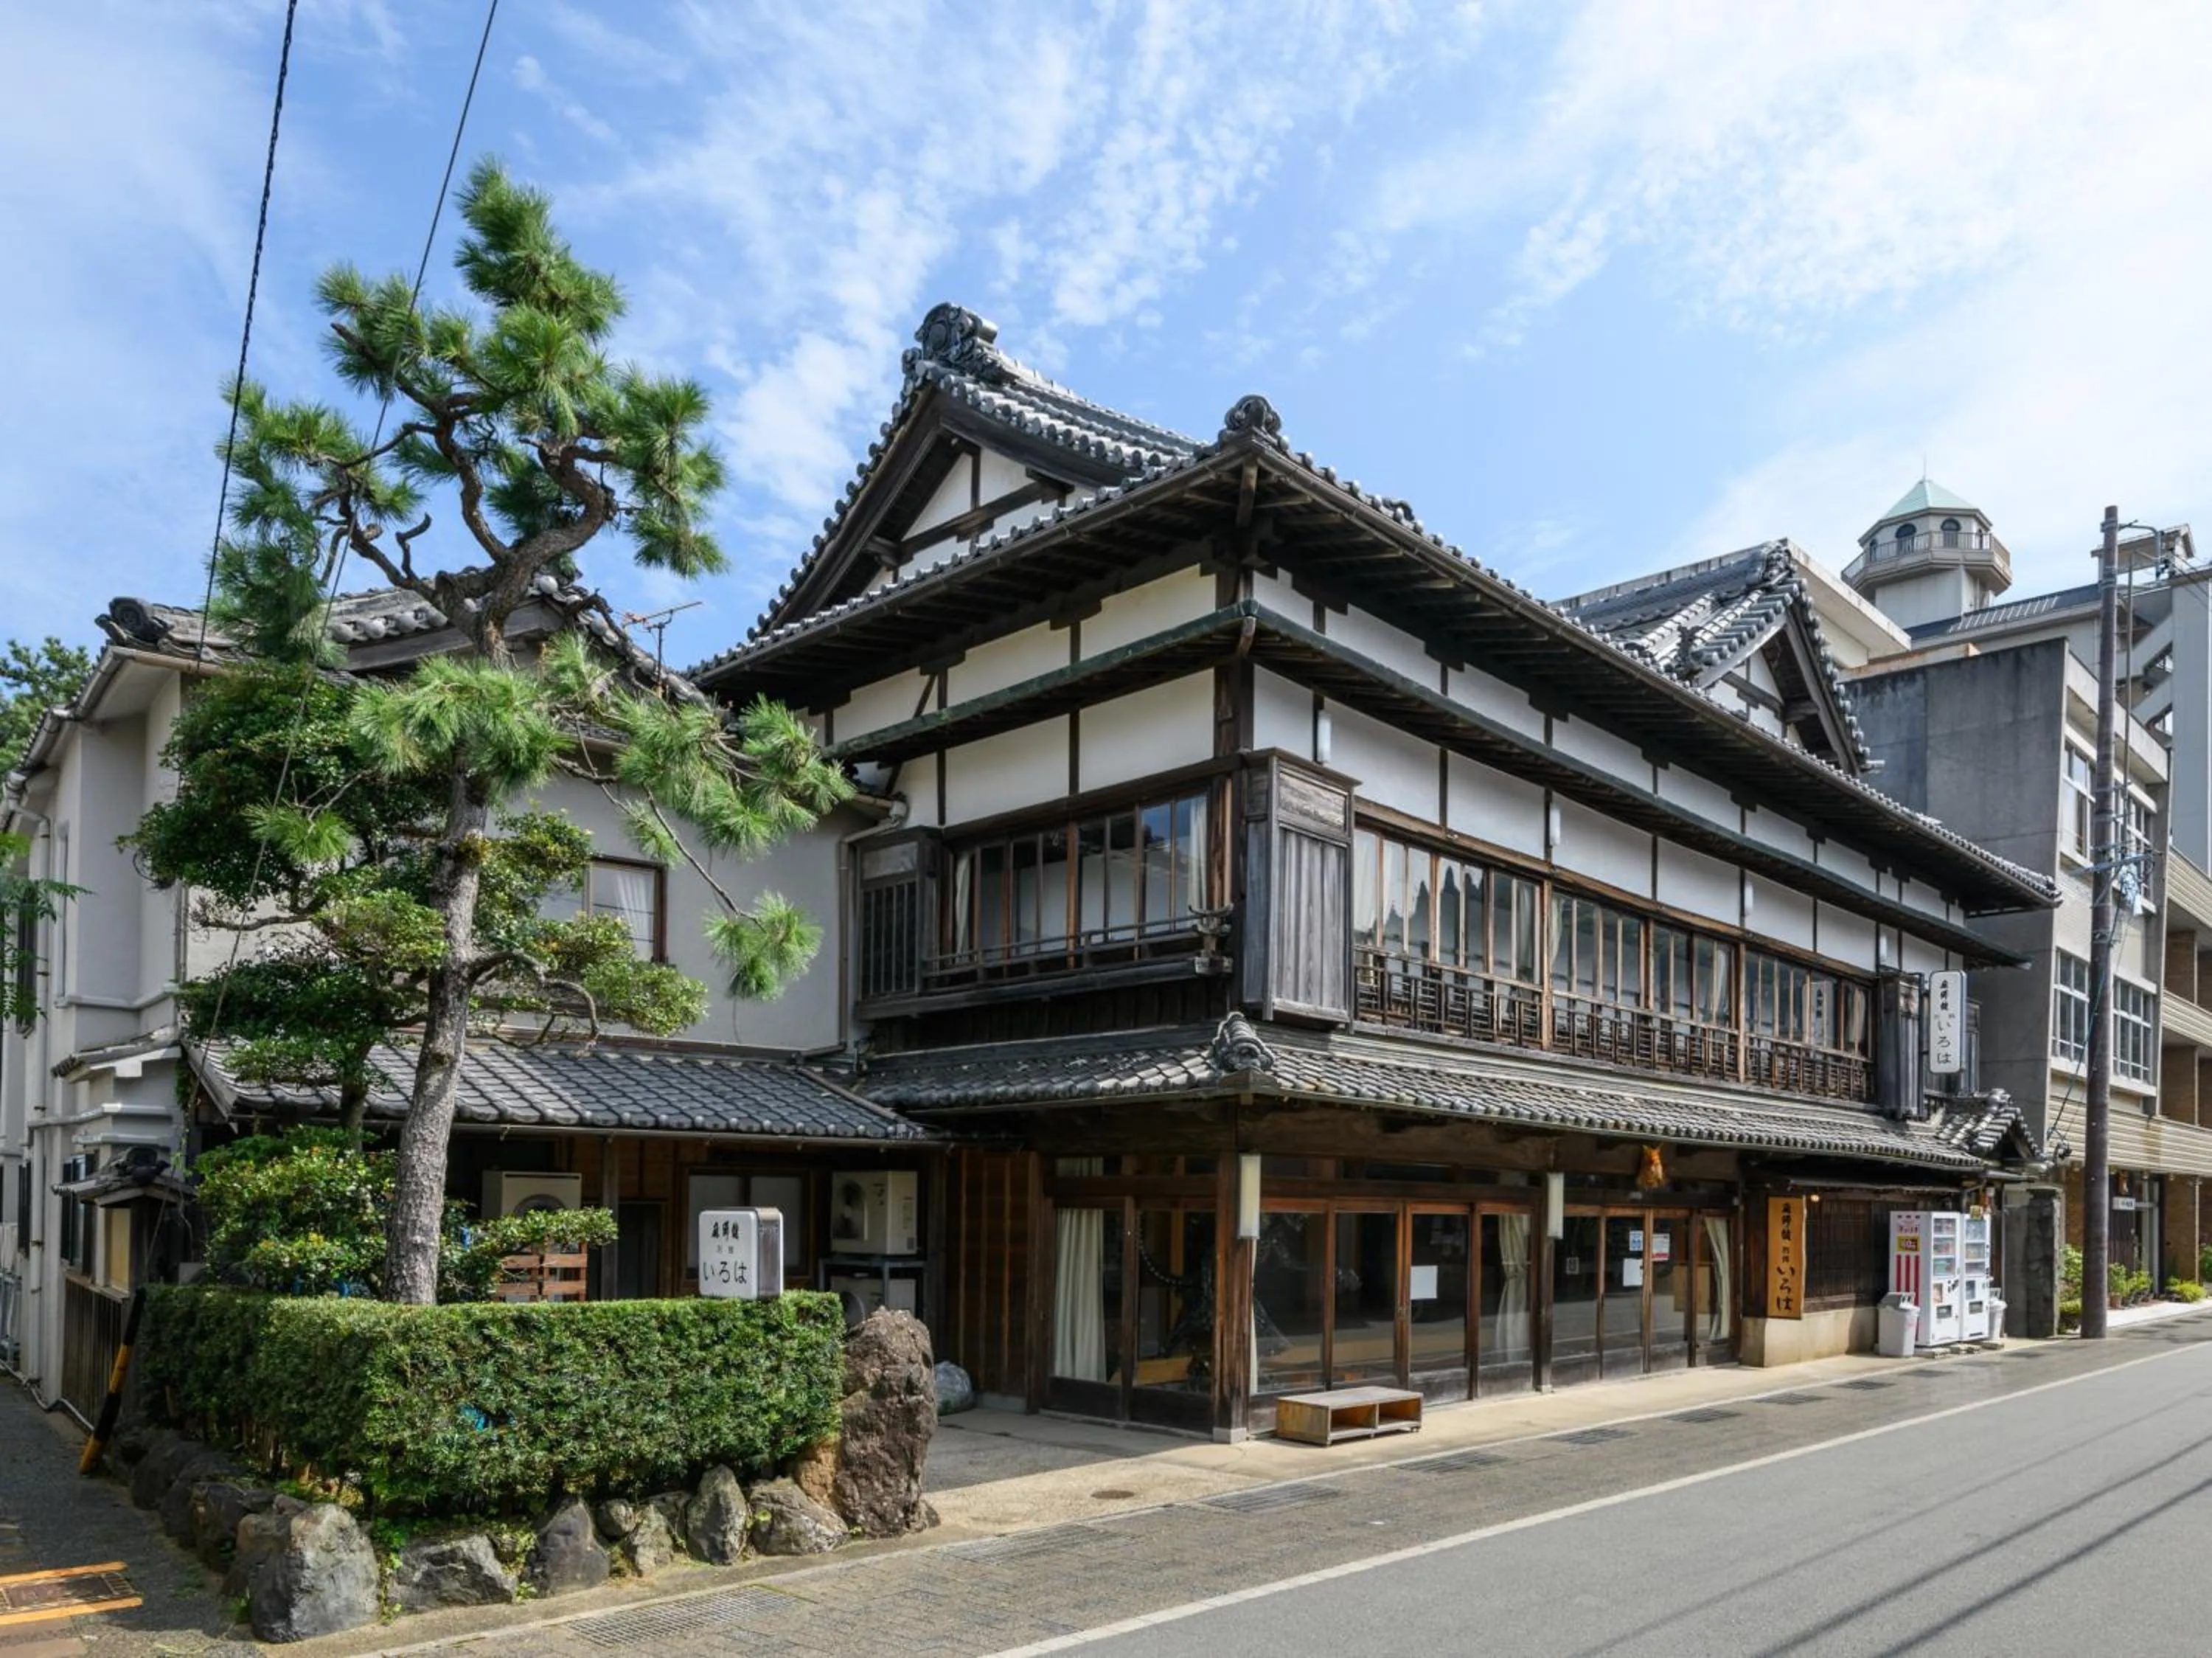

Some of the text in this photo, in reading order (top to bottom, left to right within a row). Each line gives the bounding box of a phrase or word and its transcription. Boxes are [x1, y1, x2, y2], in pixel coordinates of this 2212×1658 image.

[1937, 1021, 1952, 1064] いろは
[703, 1260, 747, 1284] いろは
[1776, 1266, 1795, 1311] いろは
